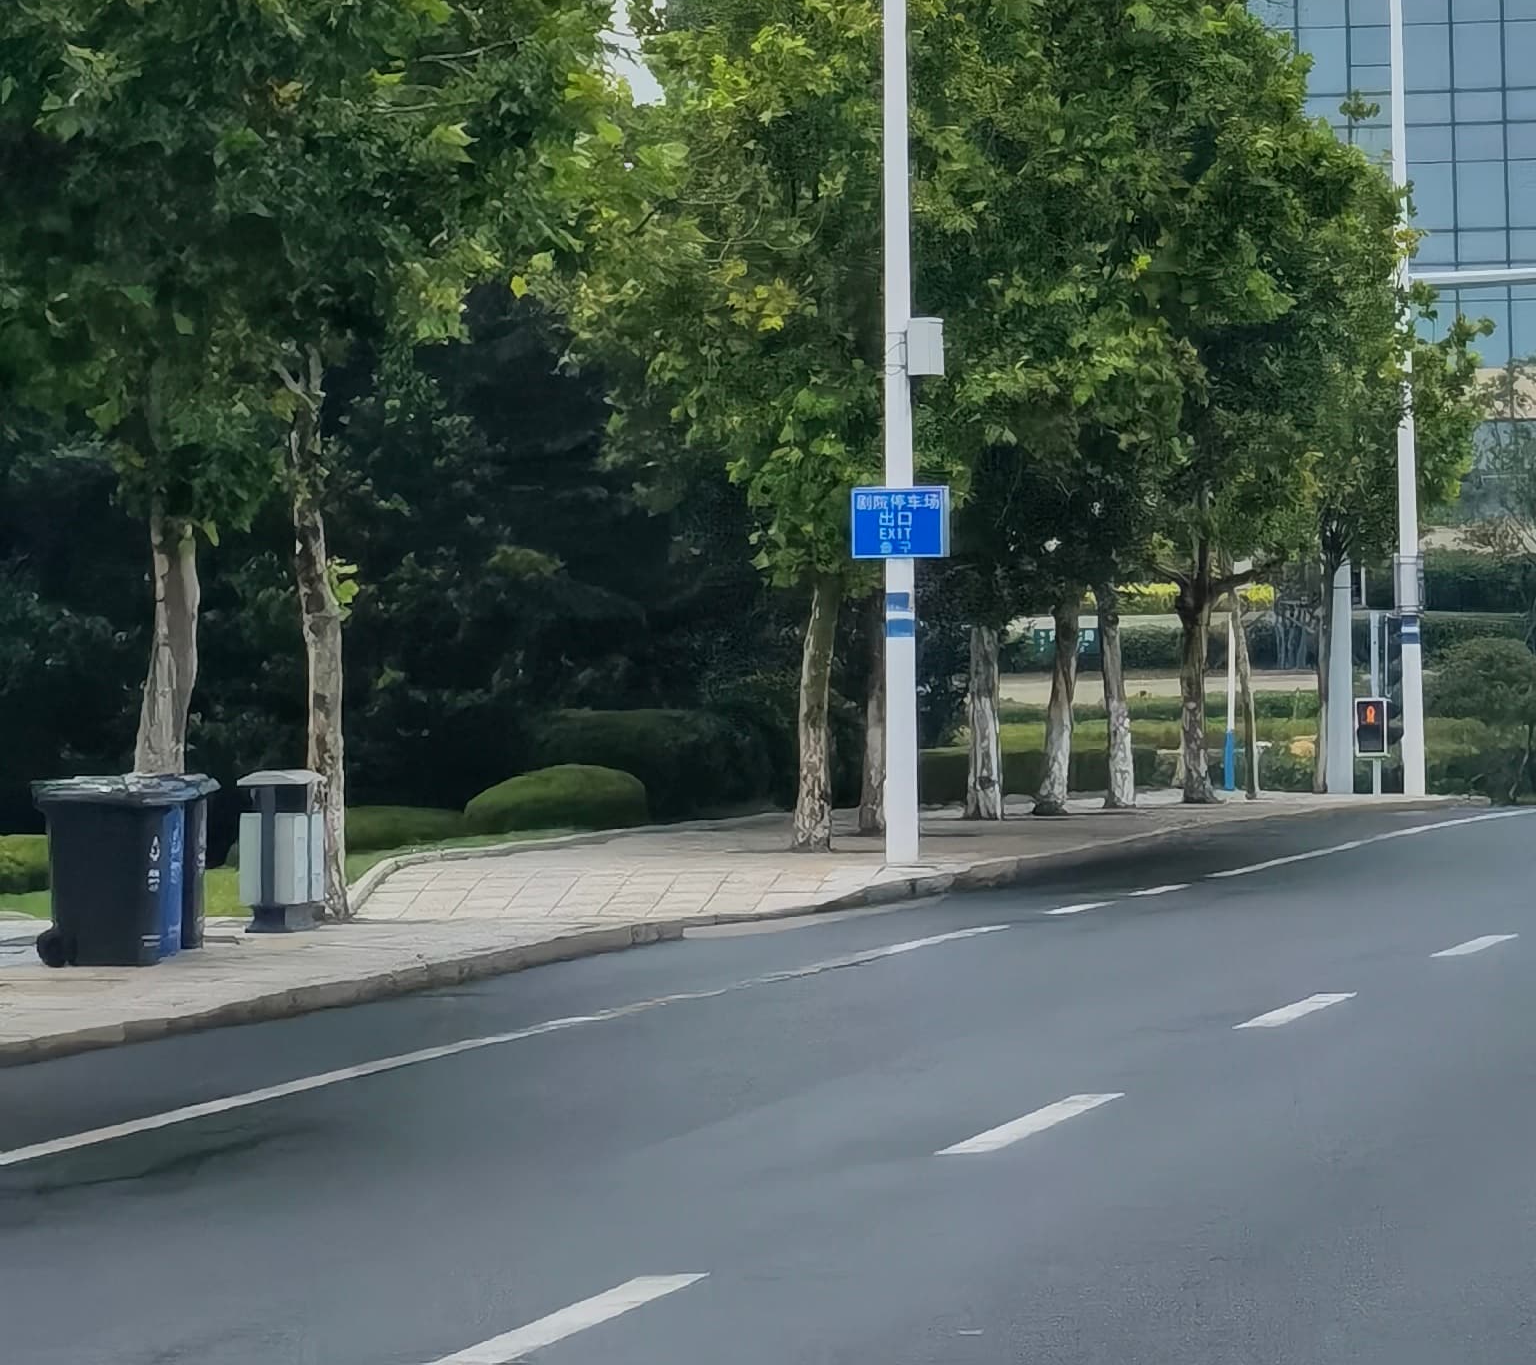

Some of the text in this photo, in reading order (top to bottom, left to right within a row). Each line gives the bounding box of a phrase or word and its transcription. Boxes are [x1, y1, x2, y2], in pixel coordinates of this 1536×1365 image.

[856, 494, 940, 510] 剧院停车场
[879, 510, 913, 526] 出口
[880, 528, 912, 540] EXIT
